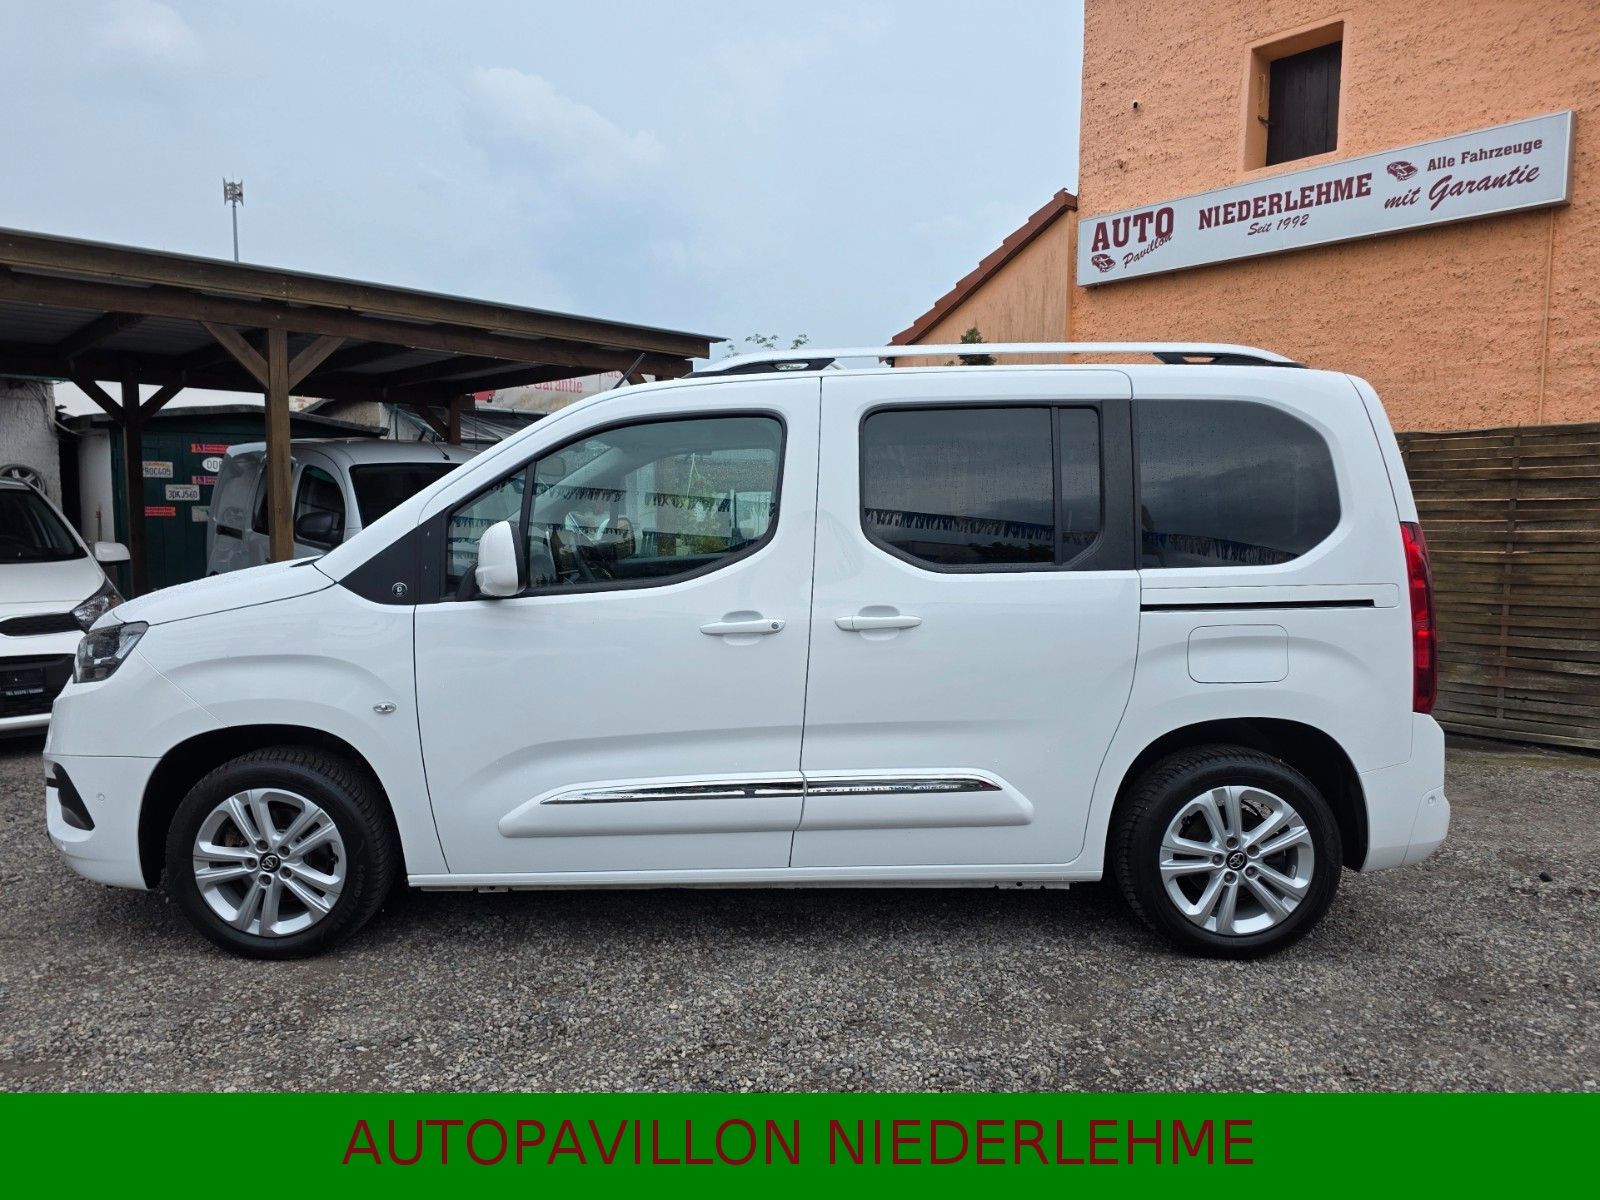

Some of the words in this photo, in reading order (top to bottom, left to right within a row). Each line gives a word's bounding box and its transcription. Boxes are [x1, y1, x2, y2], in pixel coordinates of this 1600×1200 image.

[1427, 156, 1455, 172] Alle
[1460, 138, 1543, 166] Fahrzeuge
[1198, 172, 1373, 231] NIEDERLEHME
[1384, 187, 1421, 209] mit
[1428, 164, 1540, 211] Garantie
[1091, 206, 1175, 253] AUTO
[1247, 222, 1272, 236] Seit
[1276, 214, 1310, 231] 1992
[1122, 232, 1173, 269] Pavillon
